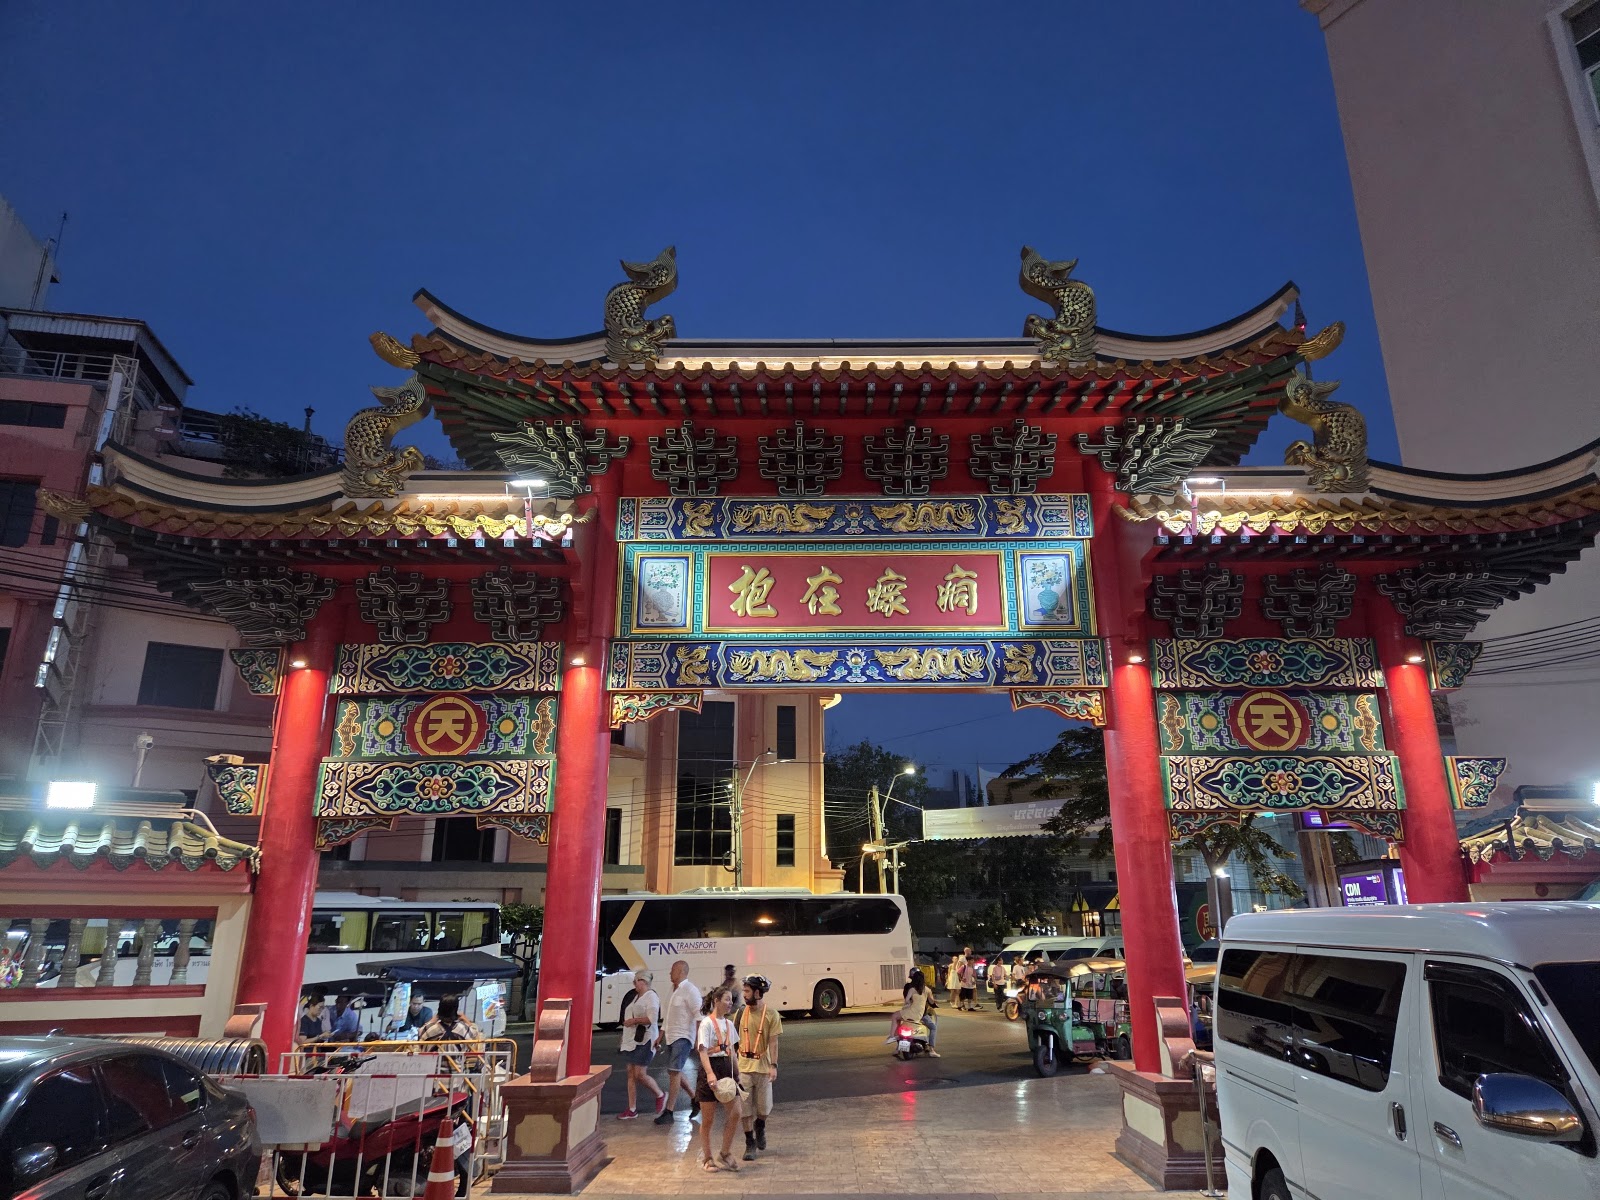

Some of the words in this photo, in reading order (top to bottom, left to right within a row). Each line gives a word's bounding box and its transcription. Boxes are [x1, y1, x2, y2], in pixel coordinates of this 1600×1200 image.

[426, 709, 466, 745] 天
[1249, 704, 1290, 740] 天
[1345, 883, 1361, 897] CDM
[648, 942, 679, 956] FM
[676, 941, 718, 950] TRANSPORT
